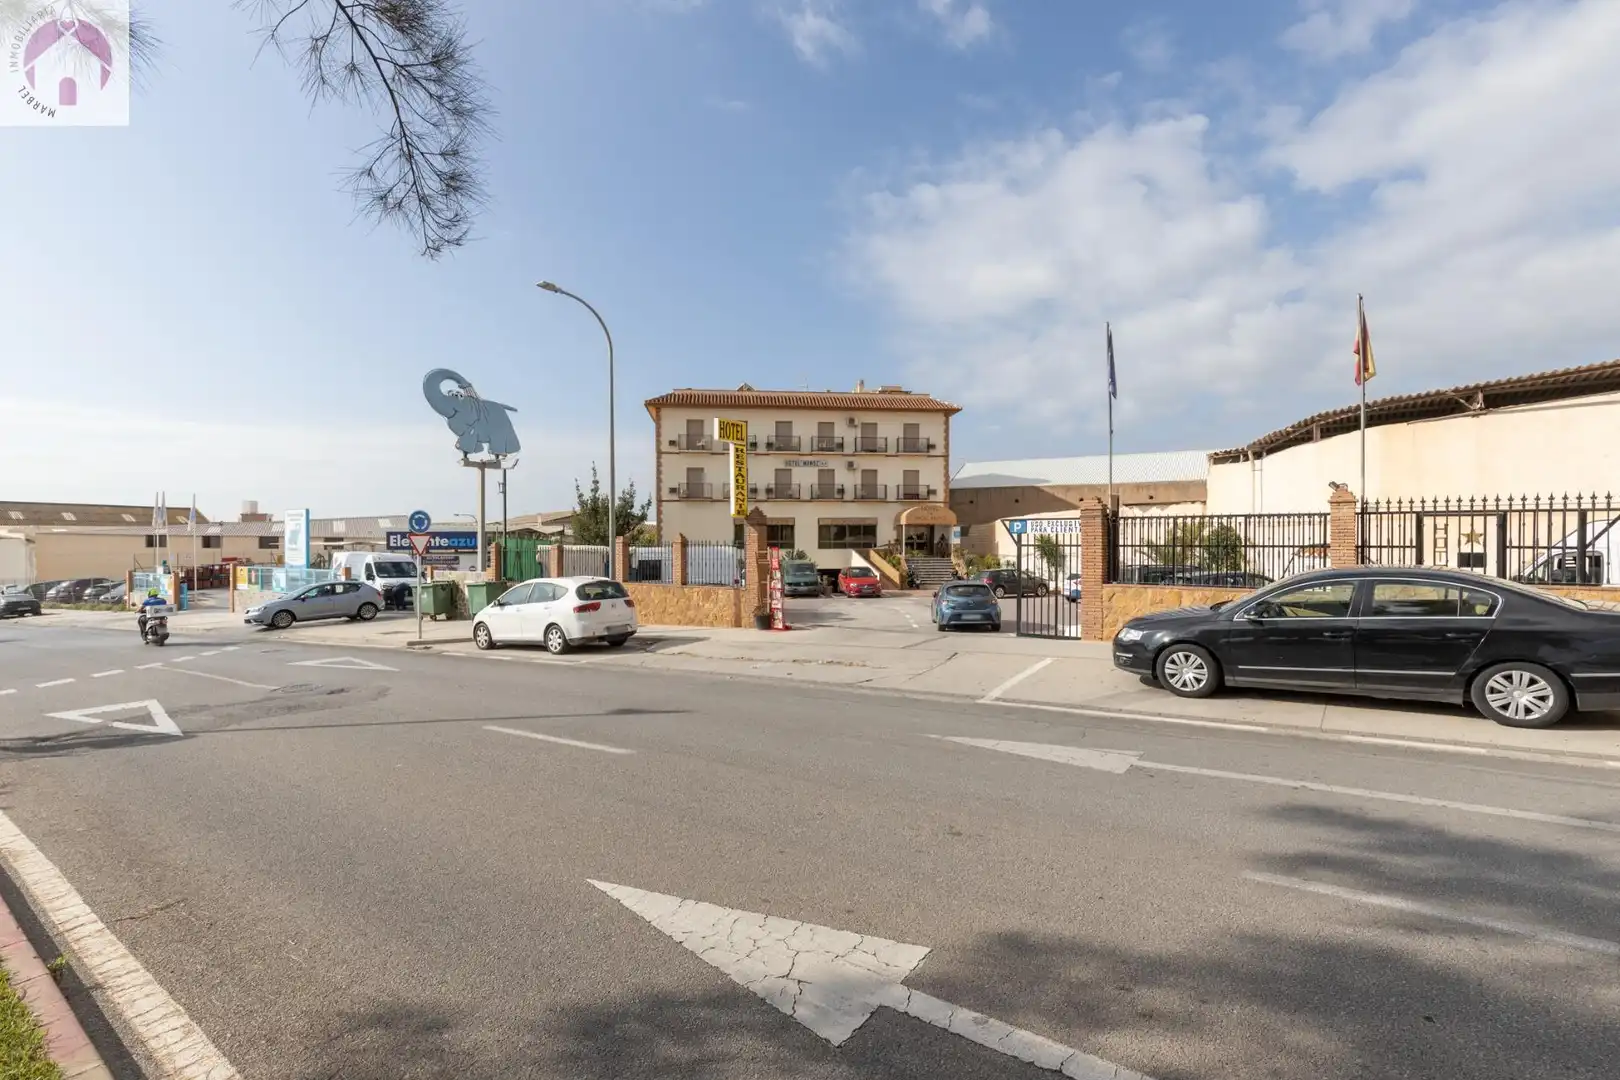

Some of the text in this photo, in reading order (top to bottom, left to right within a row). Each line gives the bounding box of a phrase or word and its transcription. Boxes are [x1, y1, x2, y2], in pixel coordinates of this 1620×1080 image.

[719, 420, 745, 441] HOTEL
[735, 447, 745, 516] RESTAURANTE
[1013, 521, 1022, 532] P
